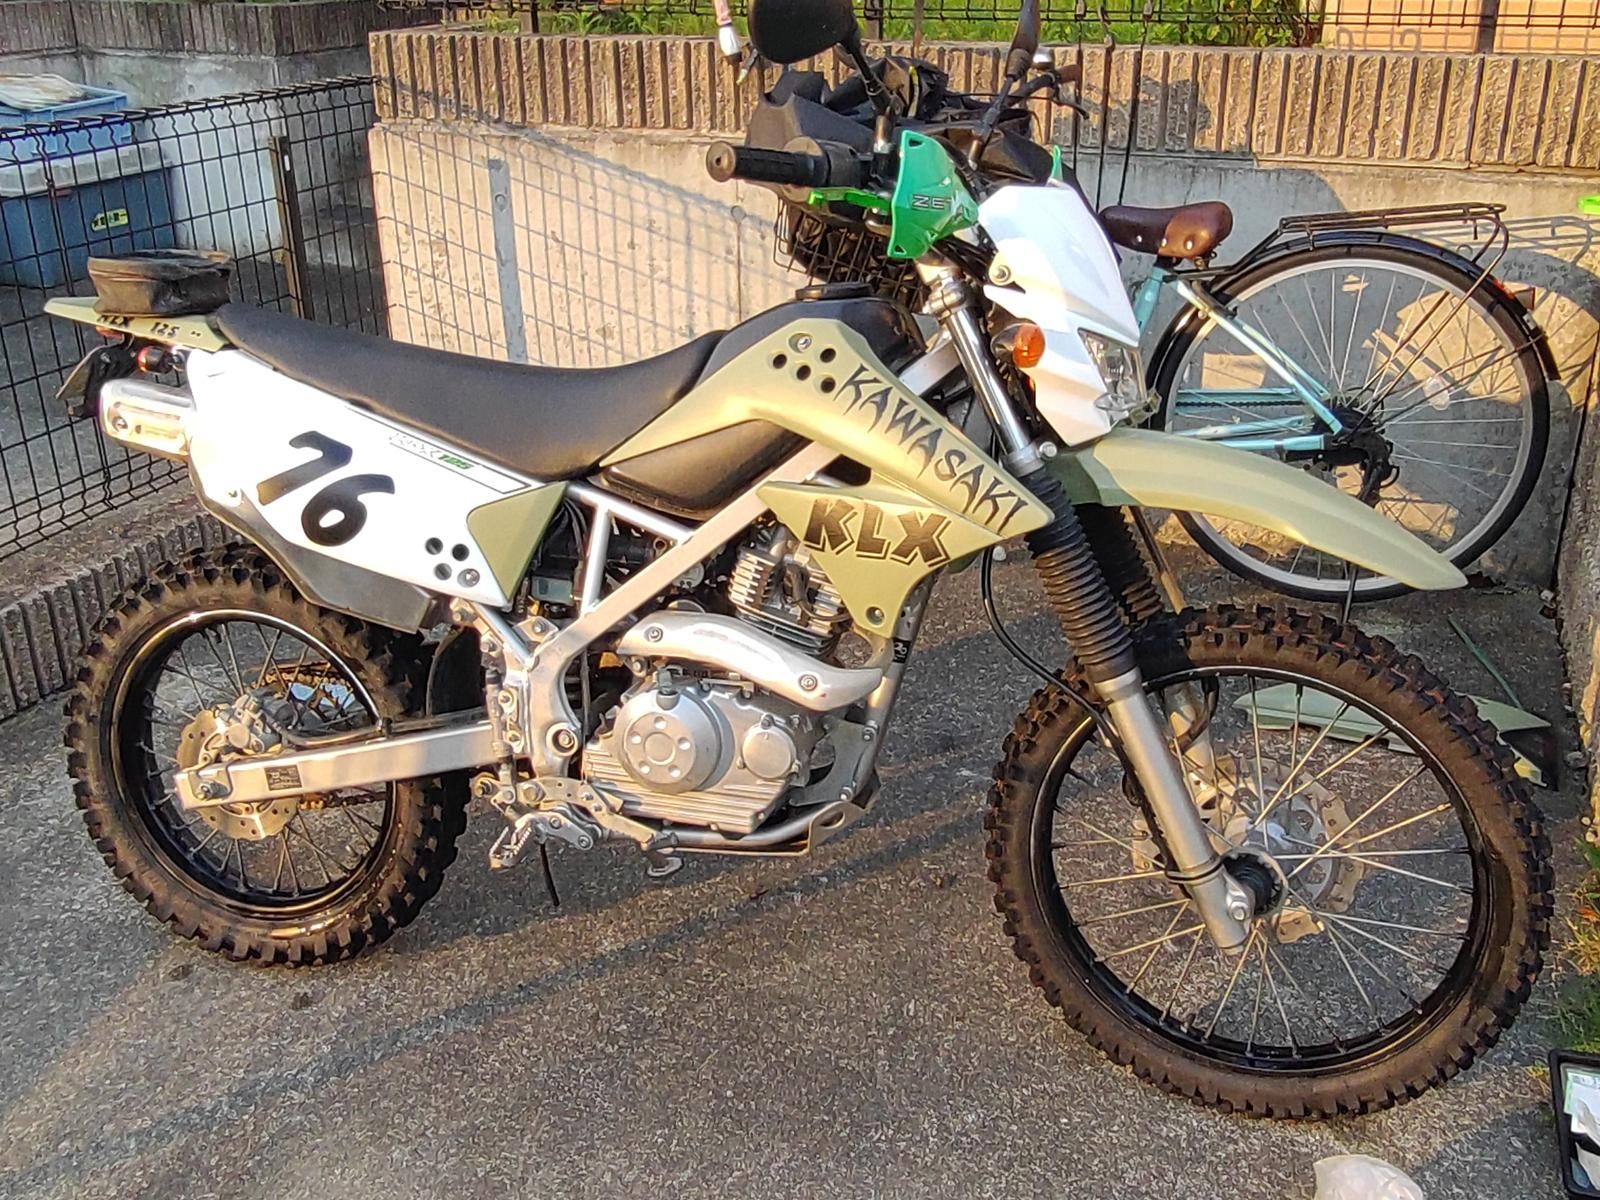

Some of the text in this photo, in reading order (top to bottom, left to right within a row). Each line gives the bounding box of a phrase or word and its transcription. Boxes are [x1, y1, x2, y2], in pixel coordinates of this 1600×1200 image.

[150, 322, 179, 338] 125
[257, 431, 395, 547] 76
[833, 364, 1028, 533] KAWASAKI
[803, 499, 952, 567] KLX
